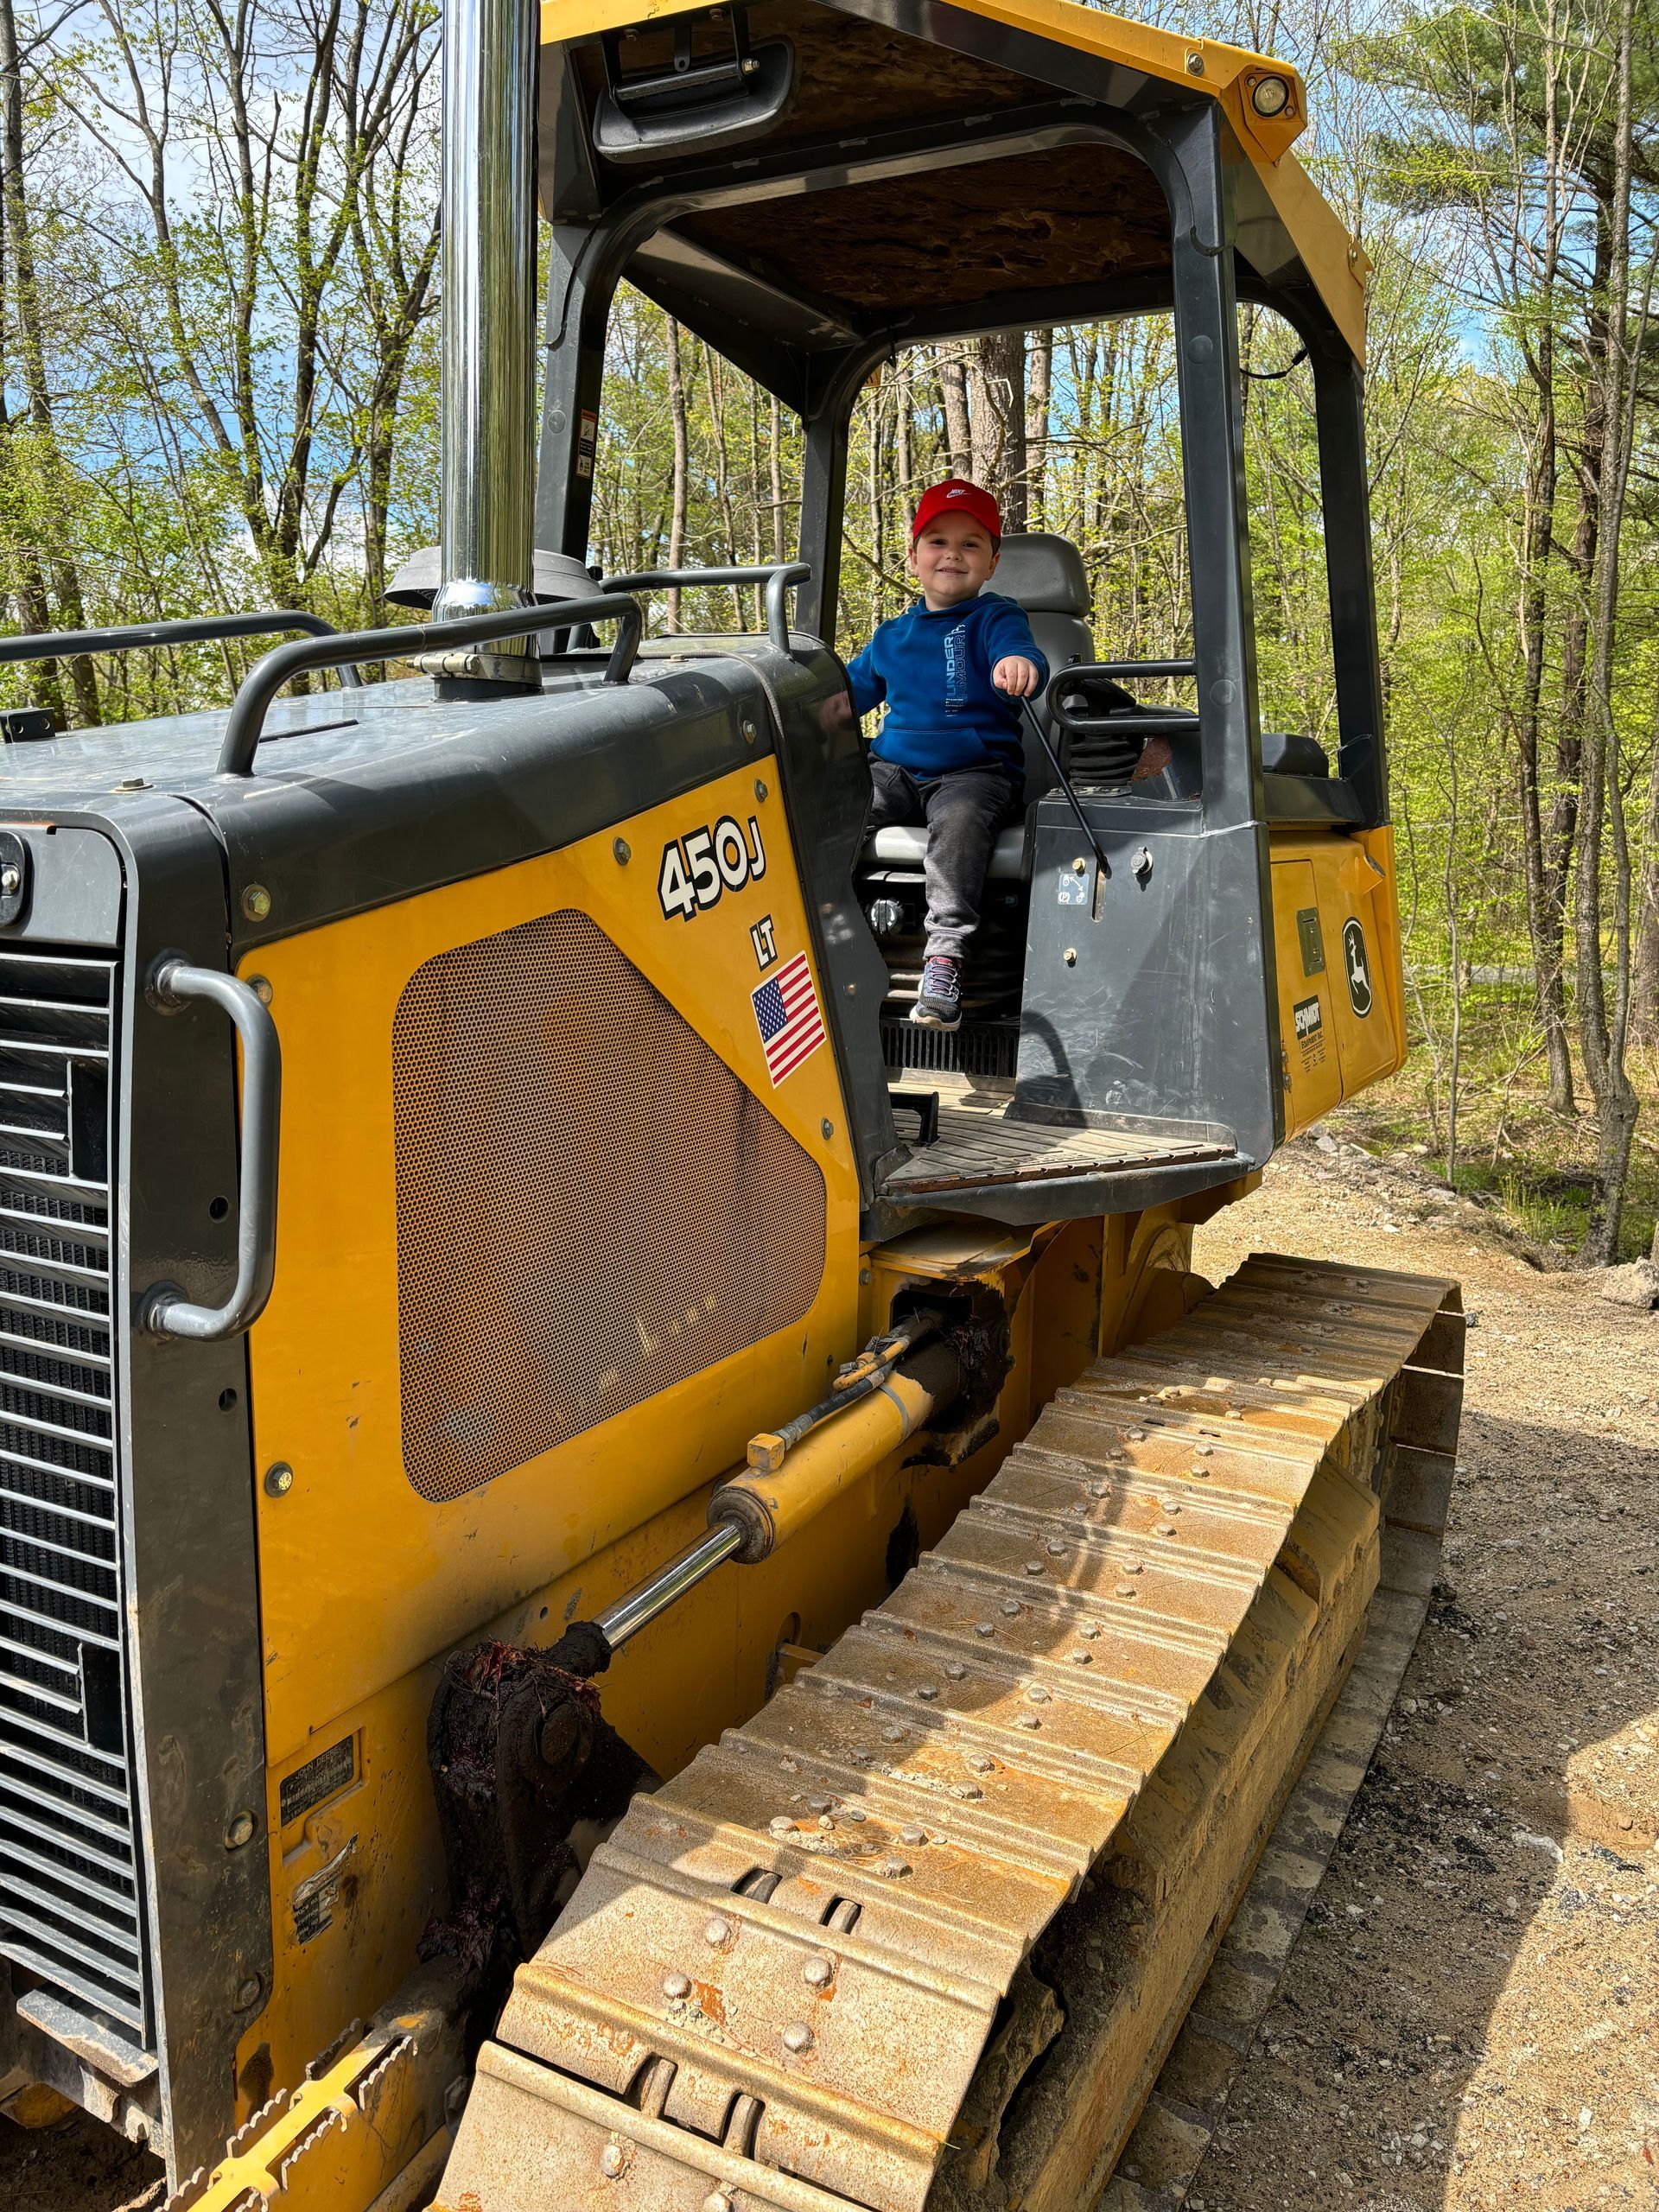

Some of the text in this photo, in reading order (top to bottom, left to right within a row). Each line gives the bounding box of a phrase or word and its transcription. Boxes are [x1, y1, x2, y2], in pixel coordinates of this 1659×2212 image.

[944, 635, 957, 696] UNDER
[954, 634, 967, 702] RMOUR
[658, 815, 766, 922] 450J
[749, 913, 778, 972] LT
[296, 1748, 339, 1779] JOHN DEERE
